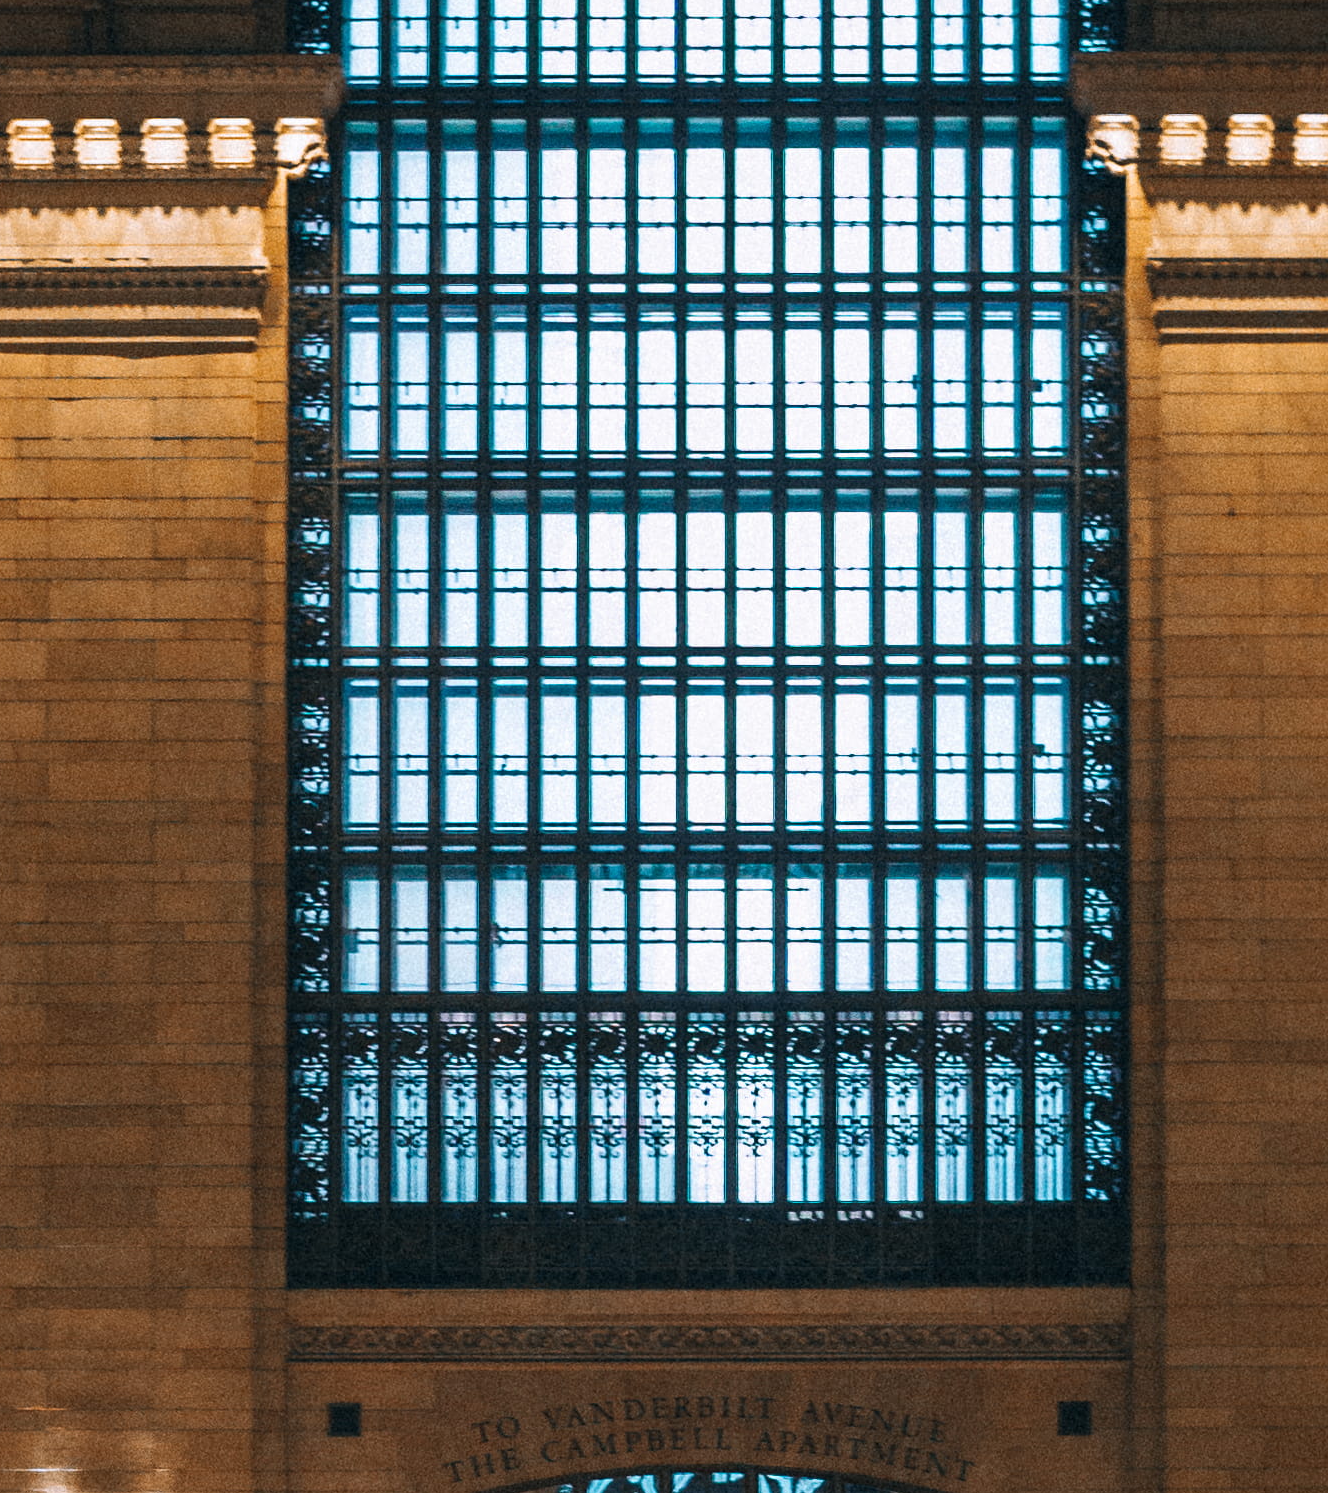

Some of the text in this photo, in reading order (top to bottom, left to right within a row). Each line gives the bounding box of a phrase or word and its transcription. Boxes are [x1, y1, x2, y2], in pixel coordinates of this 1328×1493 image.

[472, 1396, 946, 1444] TO VANDERBILT AVENUE
[442, 1427, 976, 1482] THE CAMPBELL APARTMENT
